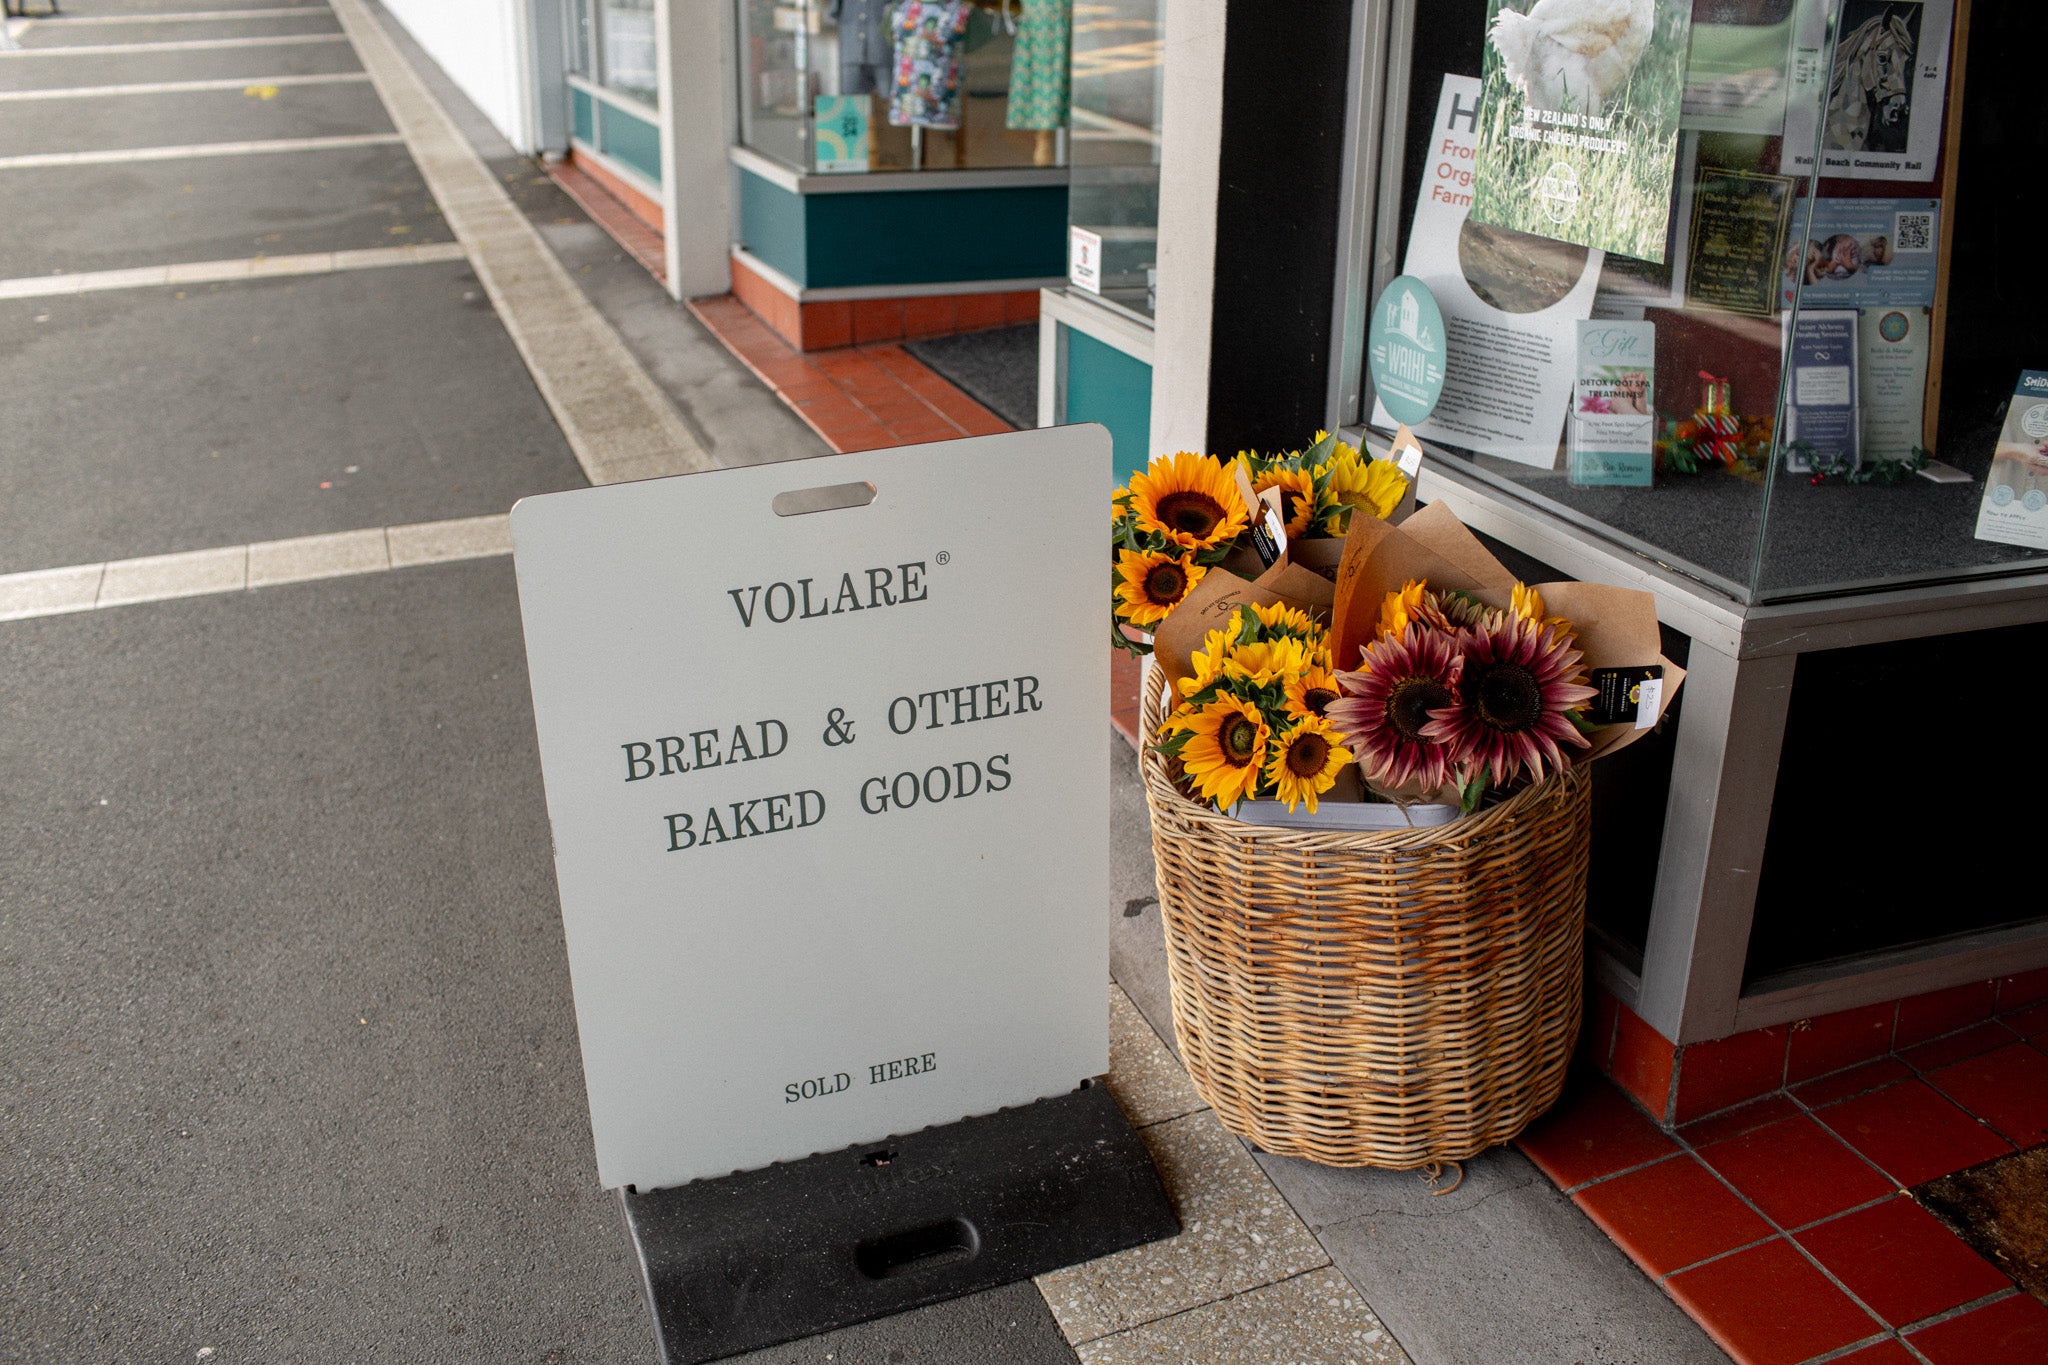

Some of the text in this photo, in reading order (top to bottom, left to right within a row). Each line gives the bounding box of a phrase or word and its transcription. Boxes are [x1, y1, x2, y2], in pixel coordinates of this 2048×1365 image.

[1524, 107, 1612, 131] NEW ZEALAND'S ONLY
[1442, 139, 1475, 159] Fro
[1509, 125, 1627, 154] ORGANIC CHICKEN PRODUCERS
[1437, 163, 1475, 186] Org
[1825, 157, 1850, 167] Beach
[1854, 159, 1900, 171] Community
[1905, 162, 1922, 170] Hall
[1388, 341, 1425, 384] WAIHI
[2024, 377, 2048, 387] SMiD
[727, 562, 927, 627] VOLARE
[1646, 686, 1655, 710] $25
[621, 676, 1042, 782] BREAD & OTHER
[664, 754, 1011, 852] BAKED GOODS
[785, 1052, 936, 1103] SOLD HERE
